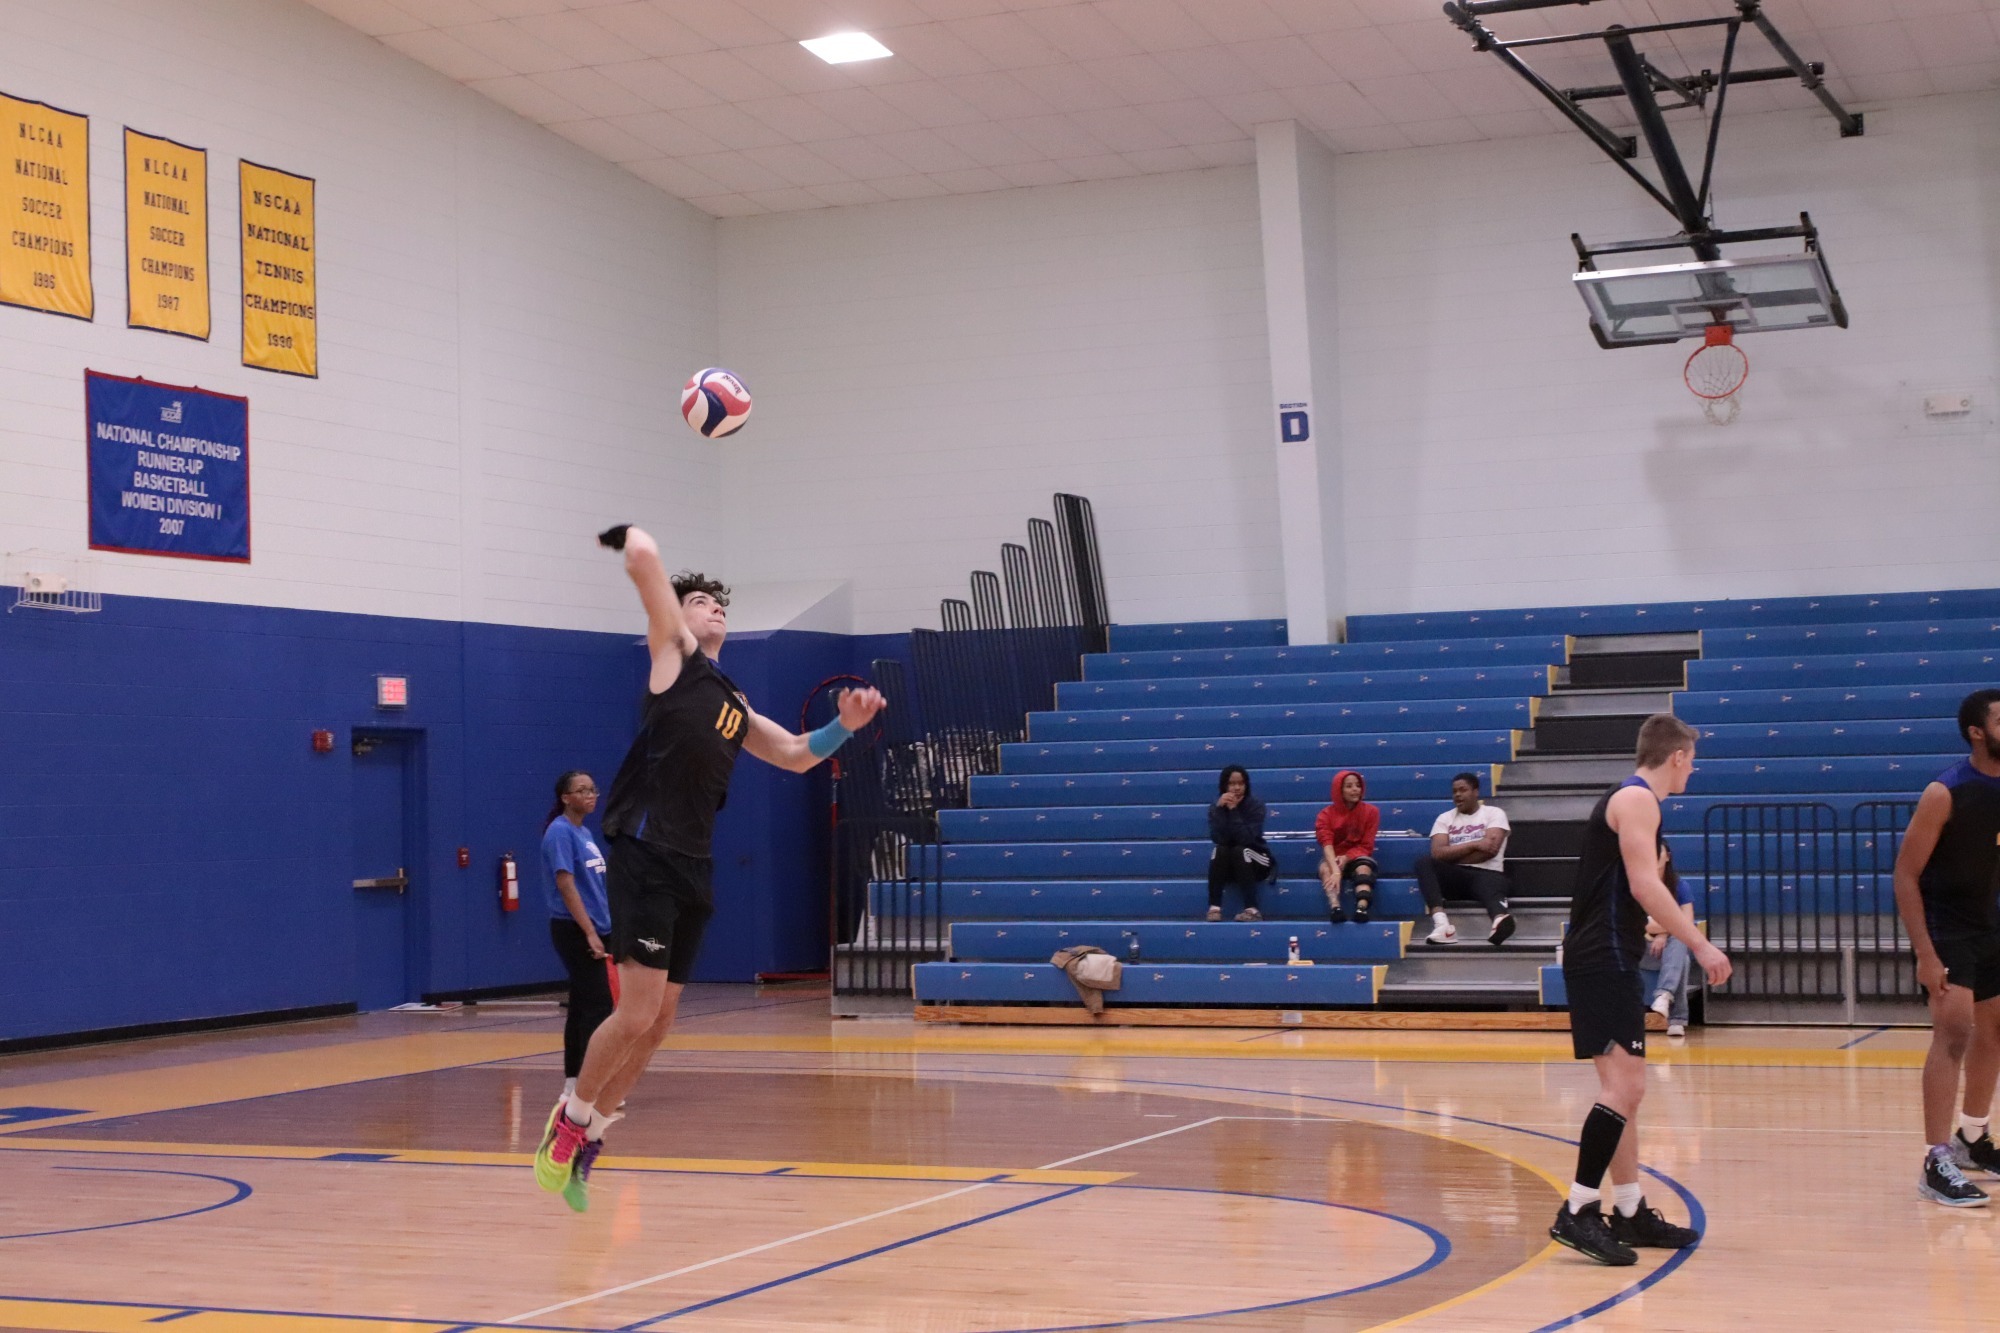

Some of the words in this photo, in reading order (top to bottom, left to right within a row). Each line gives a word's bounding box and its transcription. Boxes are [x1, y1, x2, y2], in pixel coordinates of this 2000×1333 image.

[15, 158, 68, 185] NATIONAL
[22, 196, 62, 219] SOCCER
[143, 190, 190, 216] NATIONAL
[253, 190, 302, 216] NSCAA
[11, 230, 74, 258] CHAMPIONS
[149, 225, 186, 247] SOCCER
[246, 223, 310, 252] NATIONAL
[141, 257, 195, 282] CHAMPIONS
[255, 259, 305, 284] TENNIS
[244, 293, 315, 320] CHAMPIONS
[267, 332, 293, 350] 1990
[1280, 411, 1310, 443] D
[96, 421, 156, 448] NATIONAL
[157, 432, 241, 462] CHAMPIONSHIP
[137, 450, 204, 475] RUNNER-UP
[133, 471, 209, 498] BASKETBALL
[121, 490, 166, 513] WOMEN
[166, 497, 215, 520] DIVISION
[216, 504, 222, 521] I
[159, 517, 185, 536] 2007
[715, 701, 743, 740] 10
